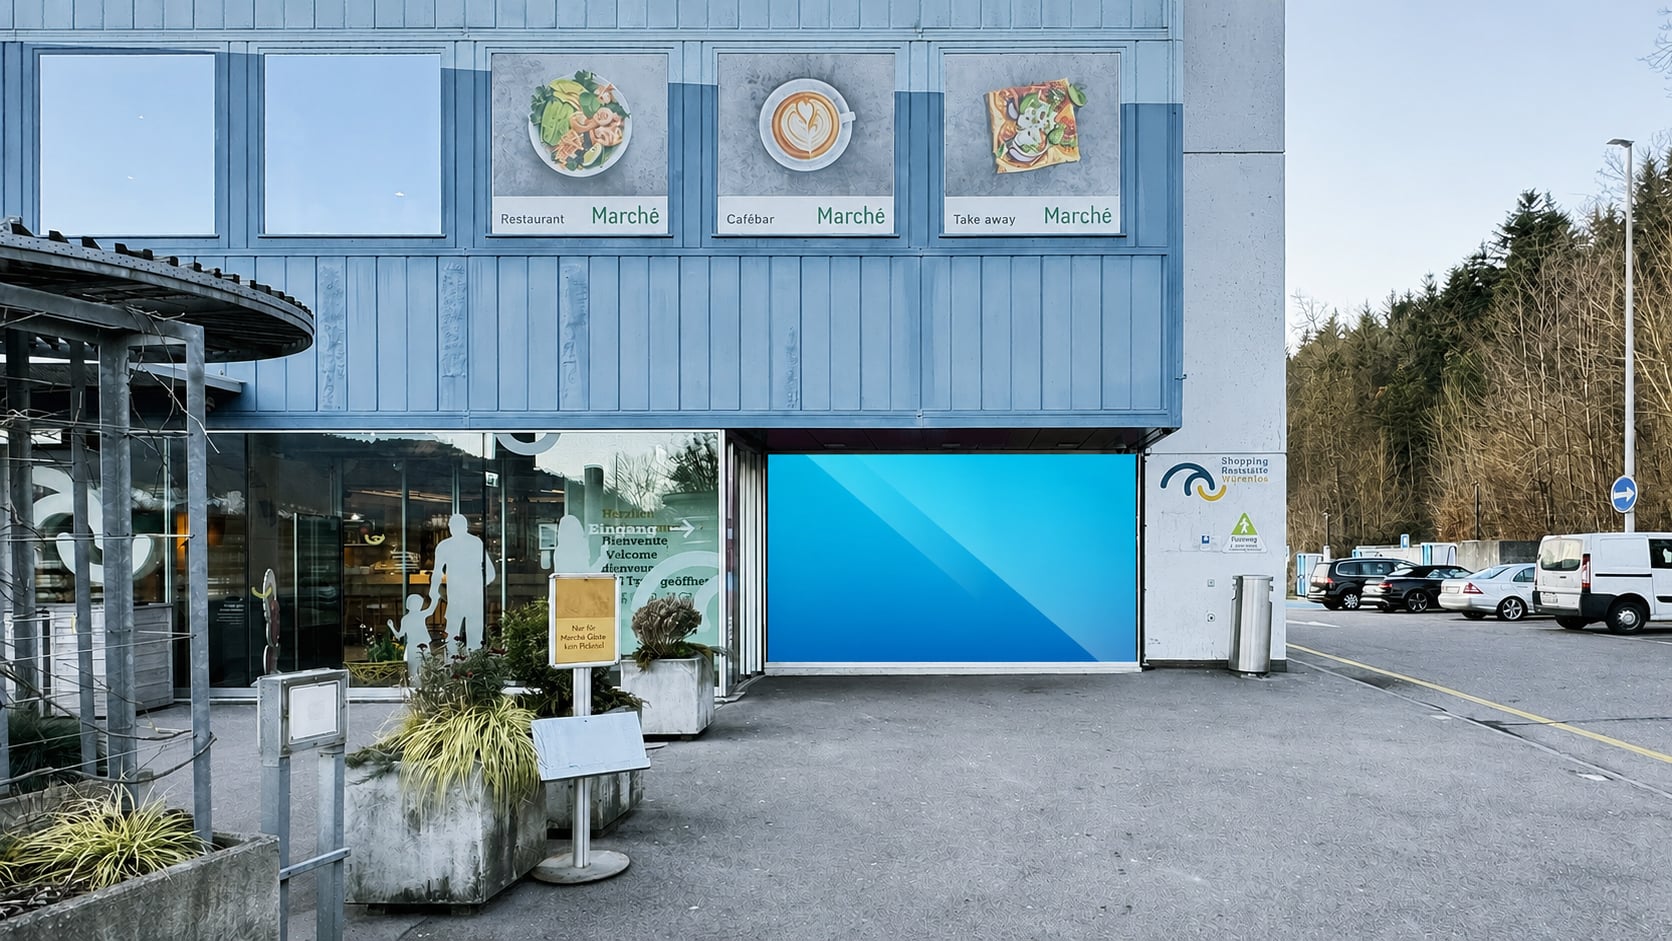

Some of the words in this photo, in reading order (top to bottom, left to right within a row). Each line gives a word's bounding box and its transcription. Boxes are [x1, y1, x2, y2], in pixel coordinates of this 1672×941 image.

[501, 213, 565, 224] Restaurant
[592, 205, 660, 224] Marché
[726, 213, 775, 224] Cafébar
[818, 205, 885, 224] Marché
[953, 214, 980, 224] Take
[985, 216, 1016, 227] away
[1044, 205, 1112, 224] Marché
[1221, 457, 1268, 467] Shopping
[588, 524, 657, 536] Eingang
